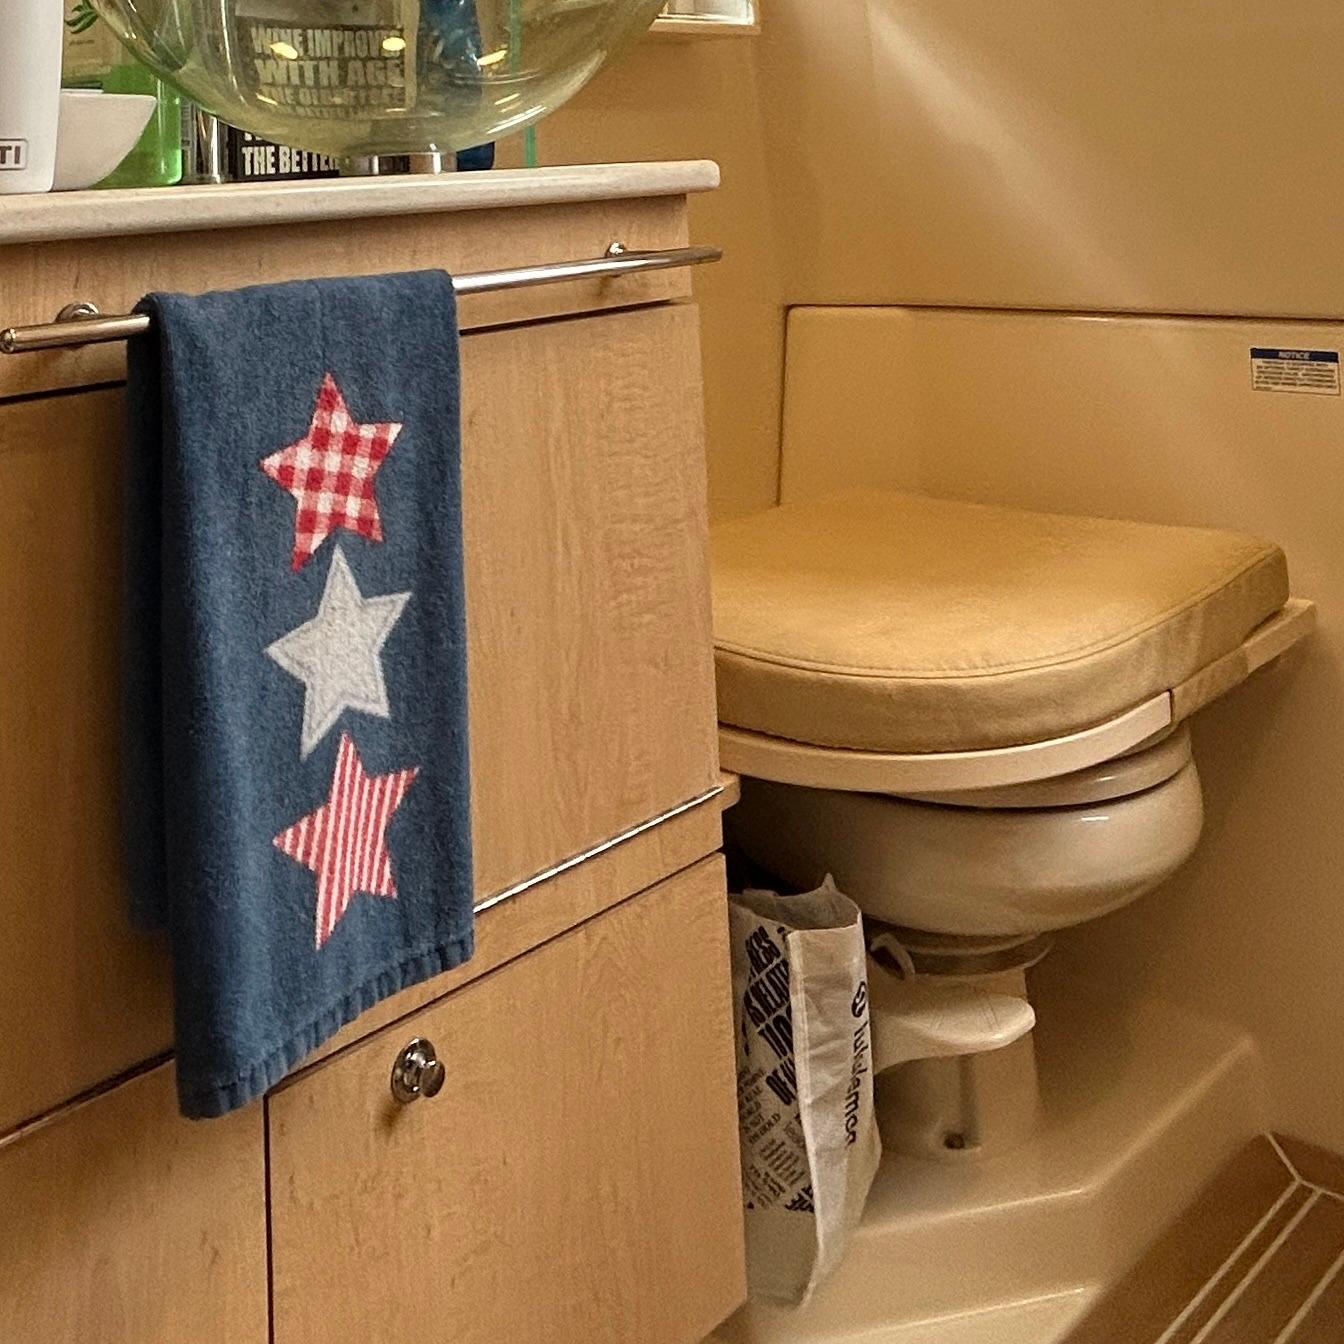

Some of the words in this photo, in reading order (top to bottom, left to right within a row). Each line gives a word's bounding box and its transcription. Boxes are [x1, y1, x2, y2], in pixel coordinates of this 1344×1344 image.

[254, 58, 340, 87] WITH
[346, 58, 405, 88] AGE
[241, 146, 276, 176] THE
